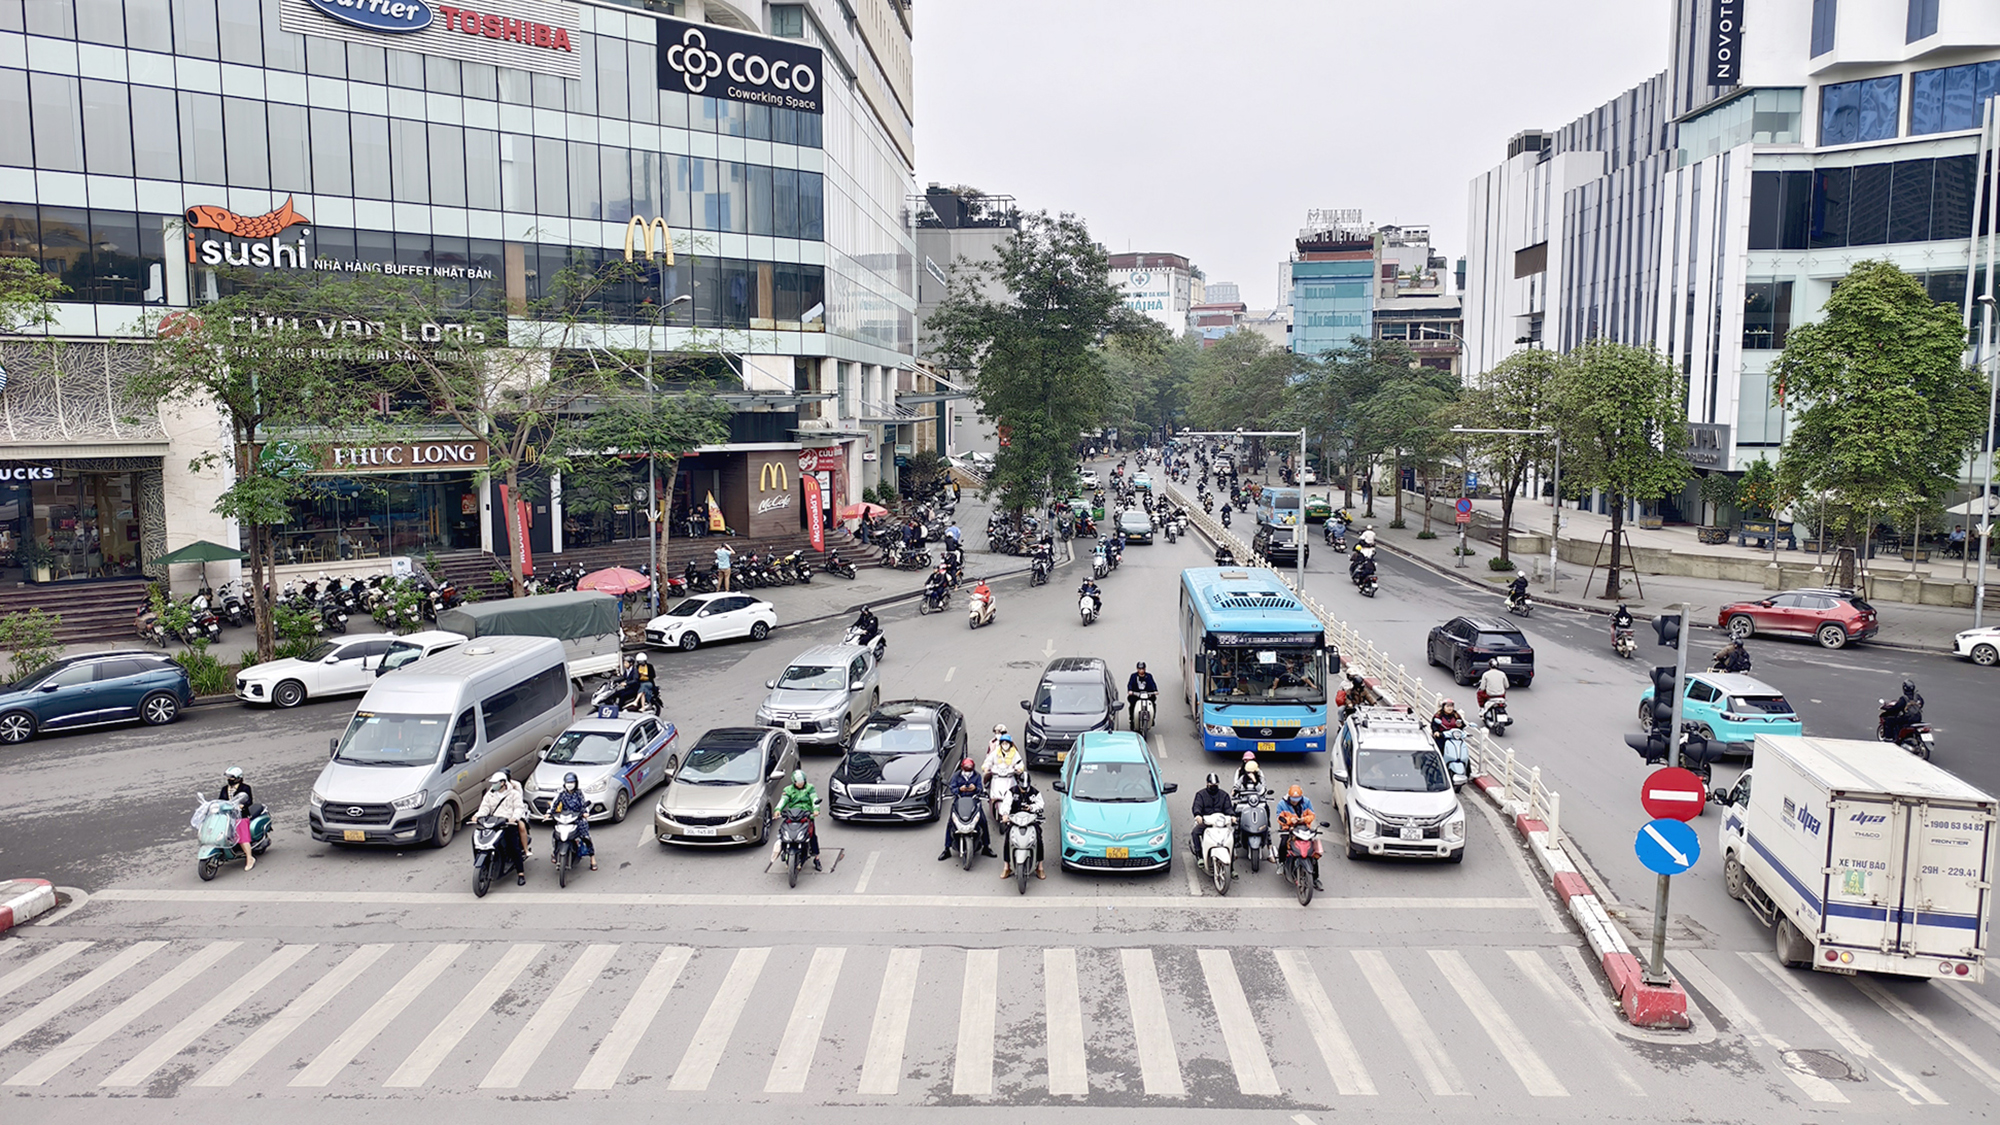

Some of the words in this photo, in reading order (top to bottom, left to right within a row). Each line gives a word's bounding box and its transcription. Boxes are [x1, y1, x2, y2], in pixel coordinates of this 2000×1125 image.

[321, 0, 420, 20] arrier
[439, 5, 572, 52] TOSHIBA
[726, 52, 816, 93] COGO
[727, 86, 783, 106] Coworking
[785, 95, 816, 110] Space
[313, 257, 341, 271] NHÀ
[345, 259, 381, 273] HÀNG
[384, 262, 431, 276] BUFFET
[433, 264, 465, 280] NHẬT
[467, 265, 492, 279] BẢN
[411, 444, 476, 465] LONG
[809, 494, 821, 543] McDonald's
[1849, 810, 1887, 826] dpa
[1930, 820, 1950, 829] 1900
[1838, 858, 1850, 868] XE
[1921, 865, 1939, 874] 29H
[1947, 867, 1977, 877] 229.41
